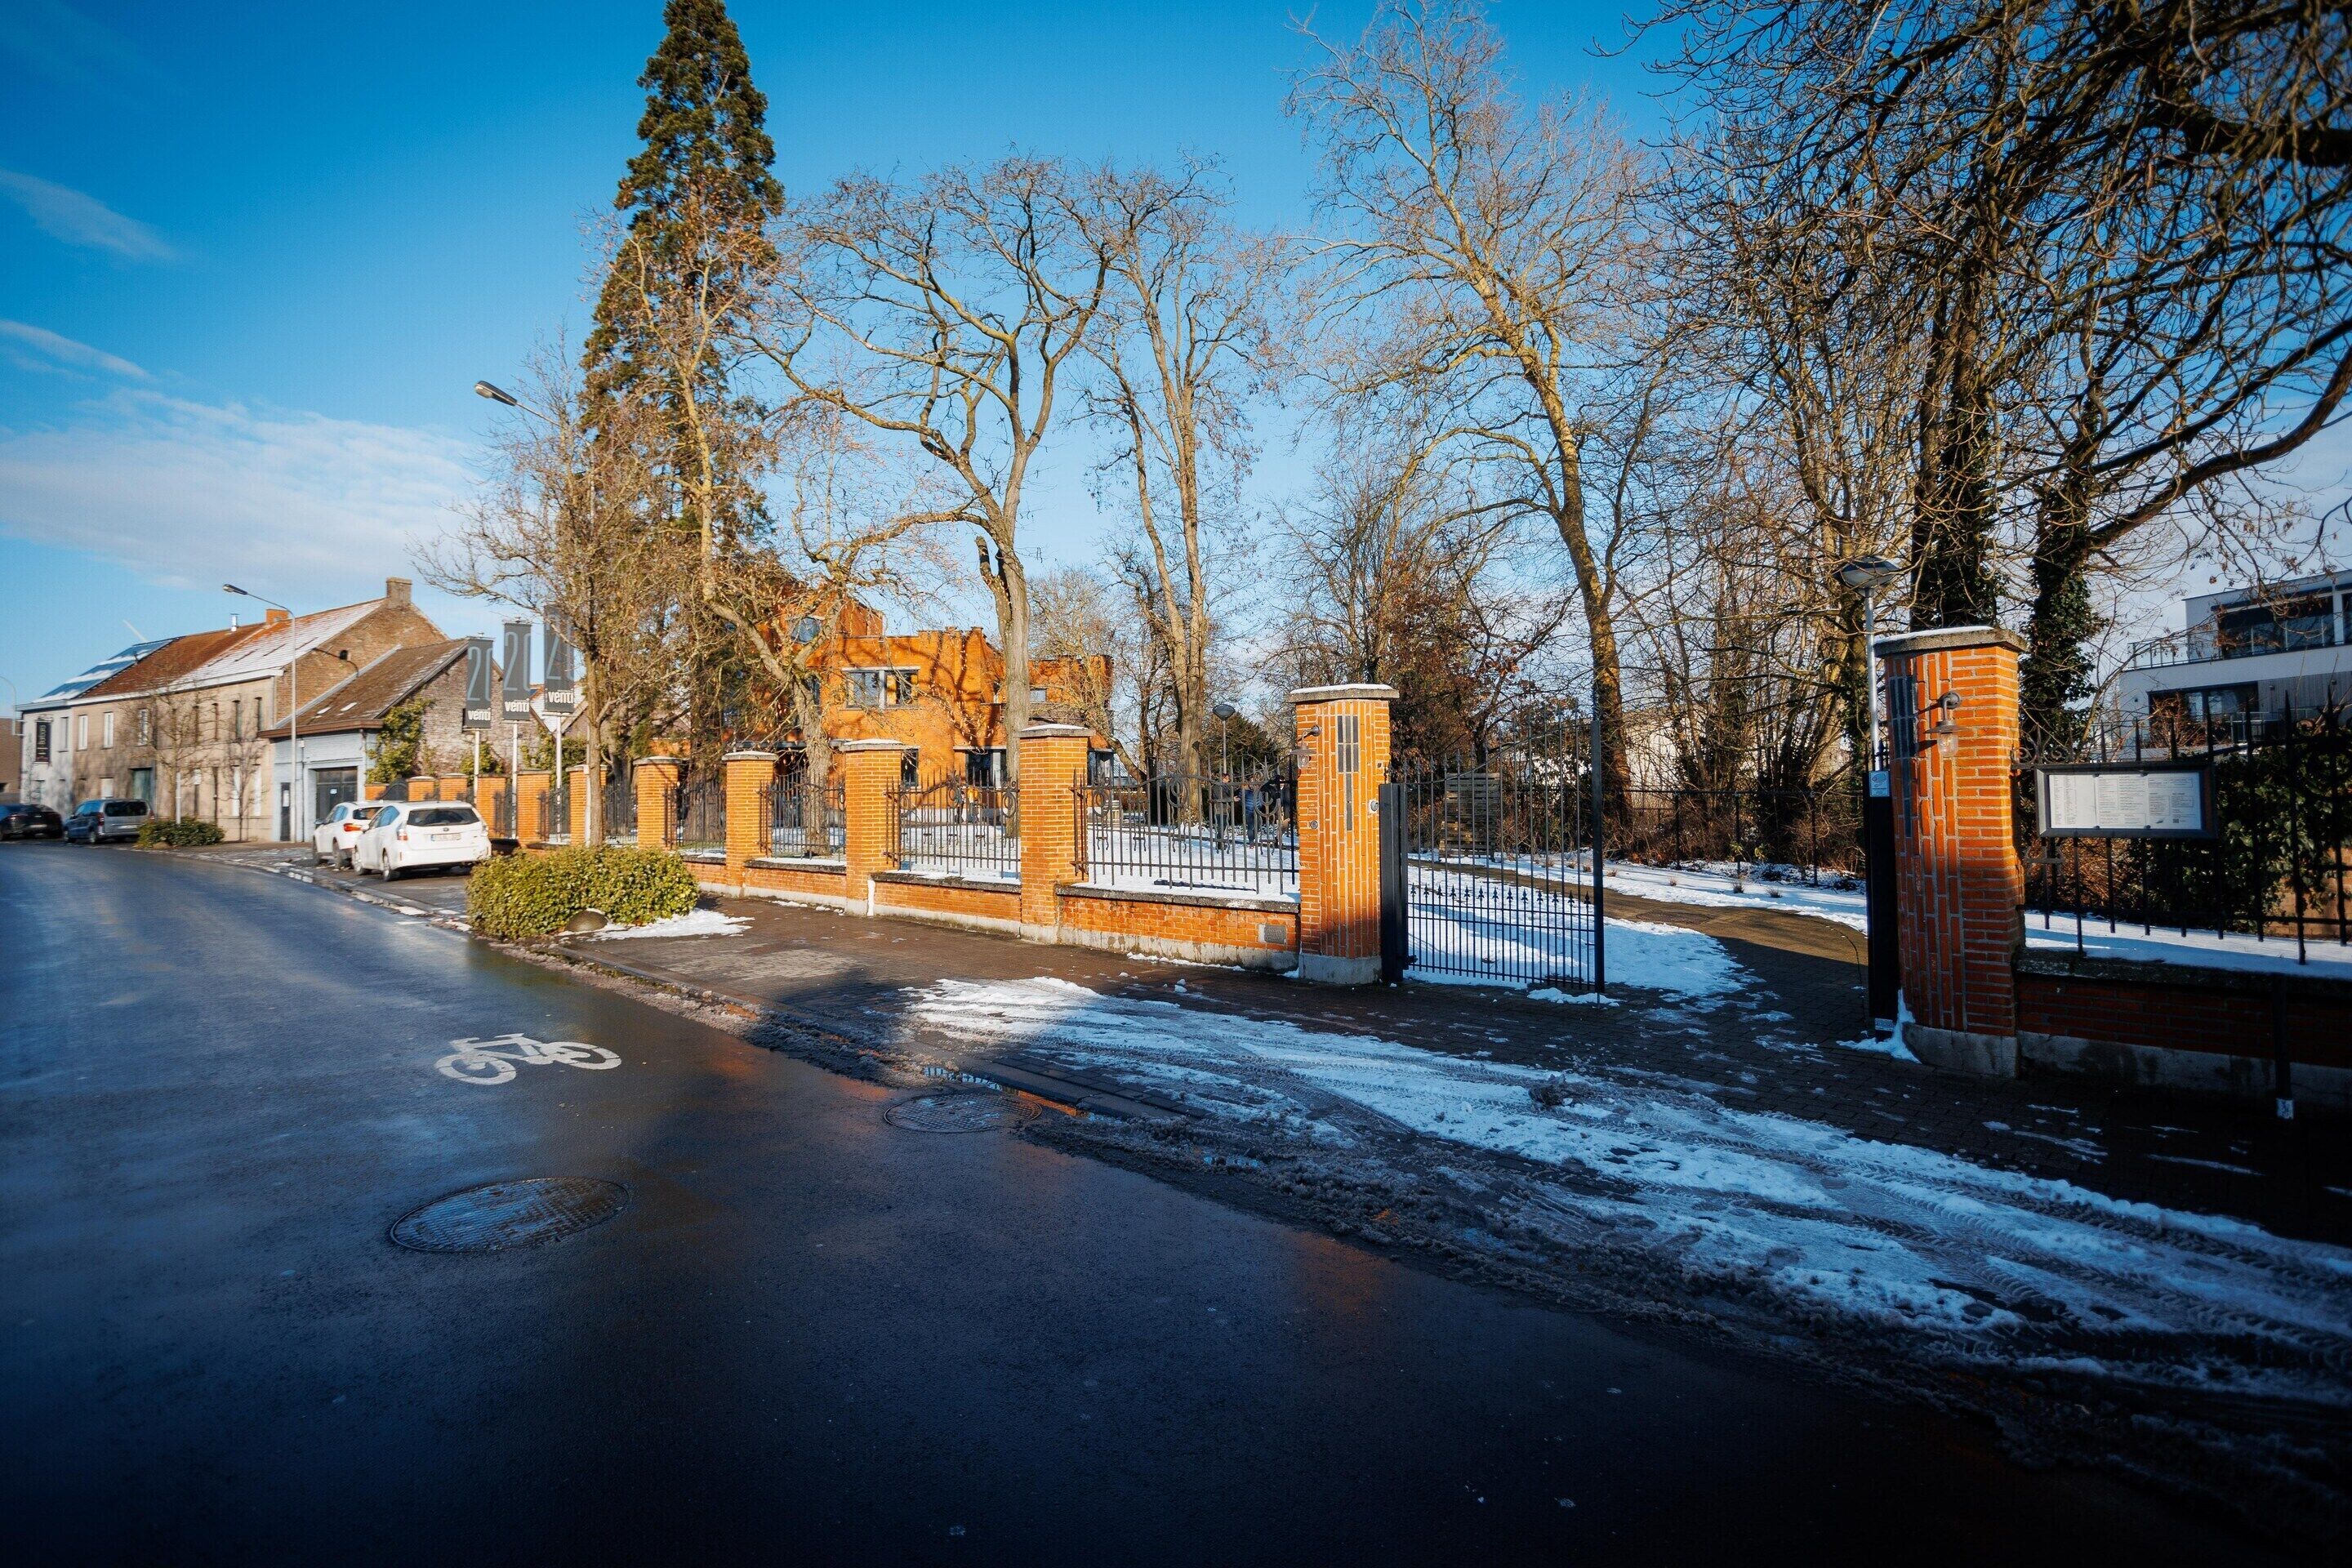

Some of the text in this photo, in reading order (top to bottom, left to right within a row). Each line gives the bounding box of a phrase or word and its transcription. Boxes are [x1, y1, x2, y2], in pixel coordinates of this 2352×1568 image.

[548, 689, 574, 703] venti
[505, 699, 529, 712] venti
[468, 708, 492, 721] venti
